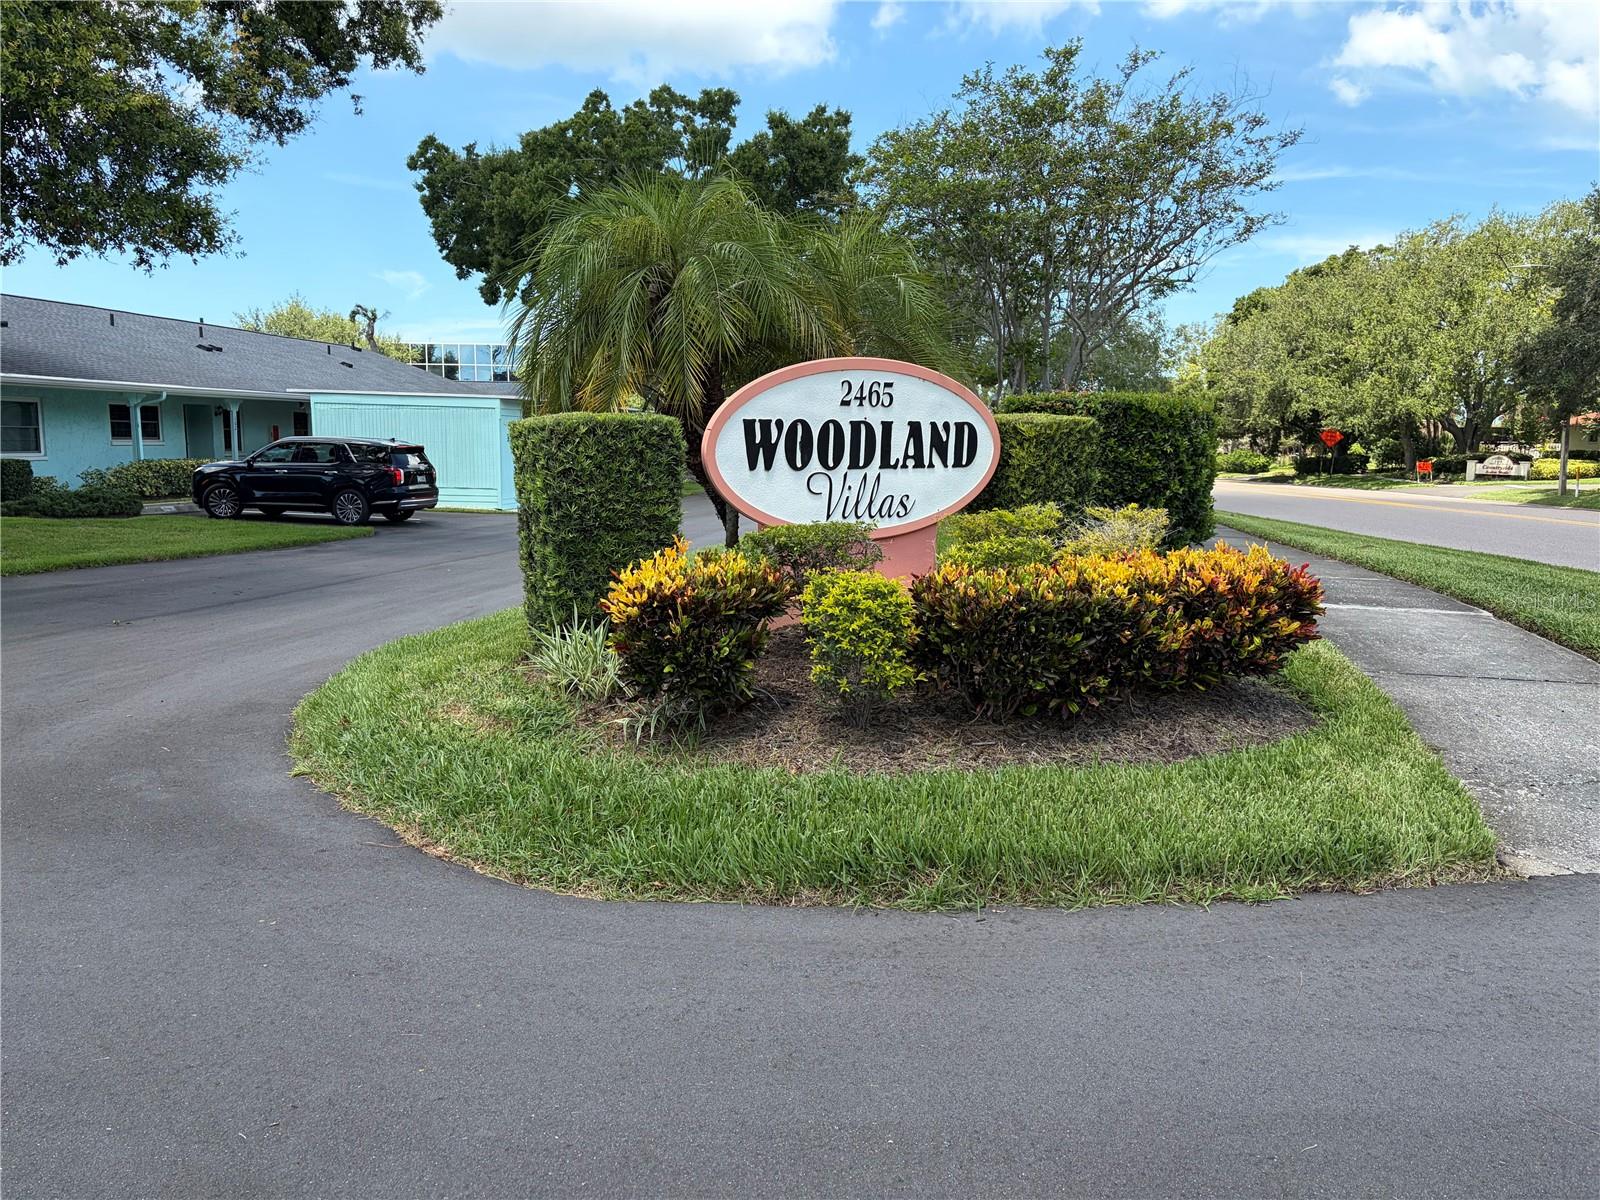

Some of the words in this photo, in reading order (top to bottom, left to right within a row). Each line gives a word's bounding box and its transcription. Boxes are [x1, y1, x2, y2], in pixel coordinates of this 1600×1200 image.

[840, 380, 894, 407] 2465
[742, 418, 978, 471] WOODLAND
[806, 471, 916, 521] Villas
